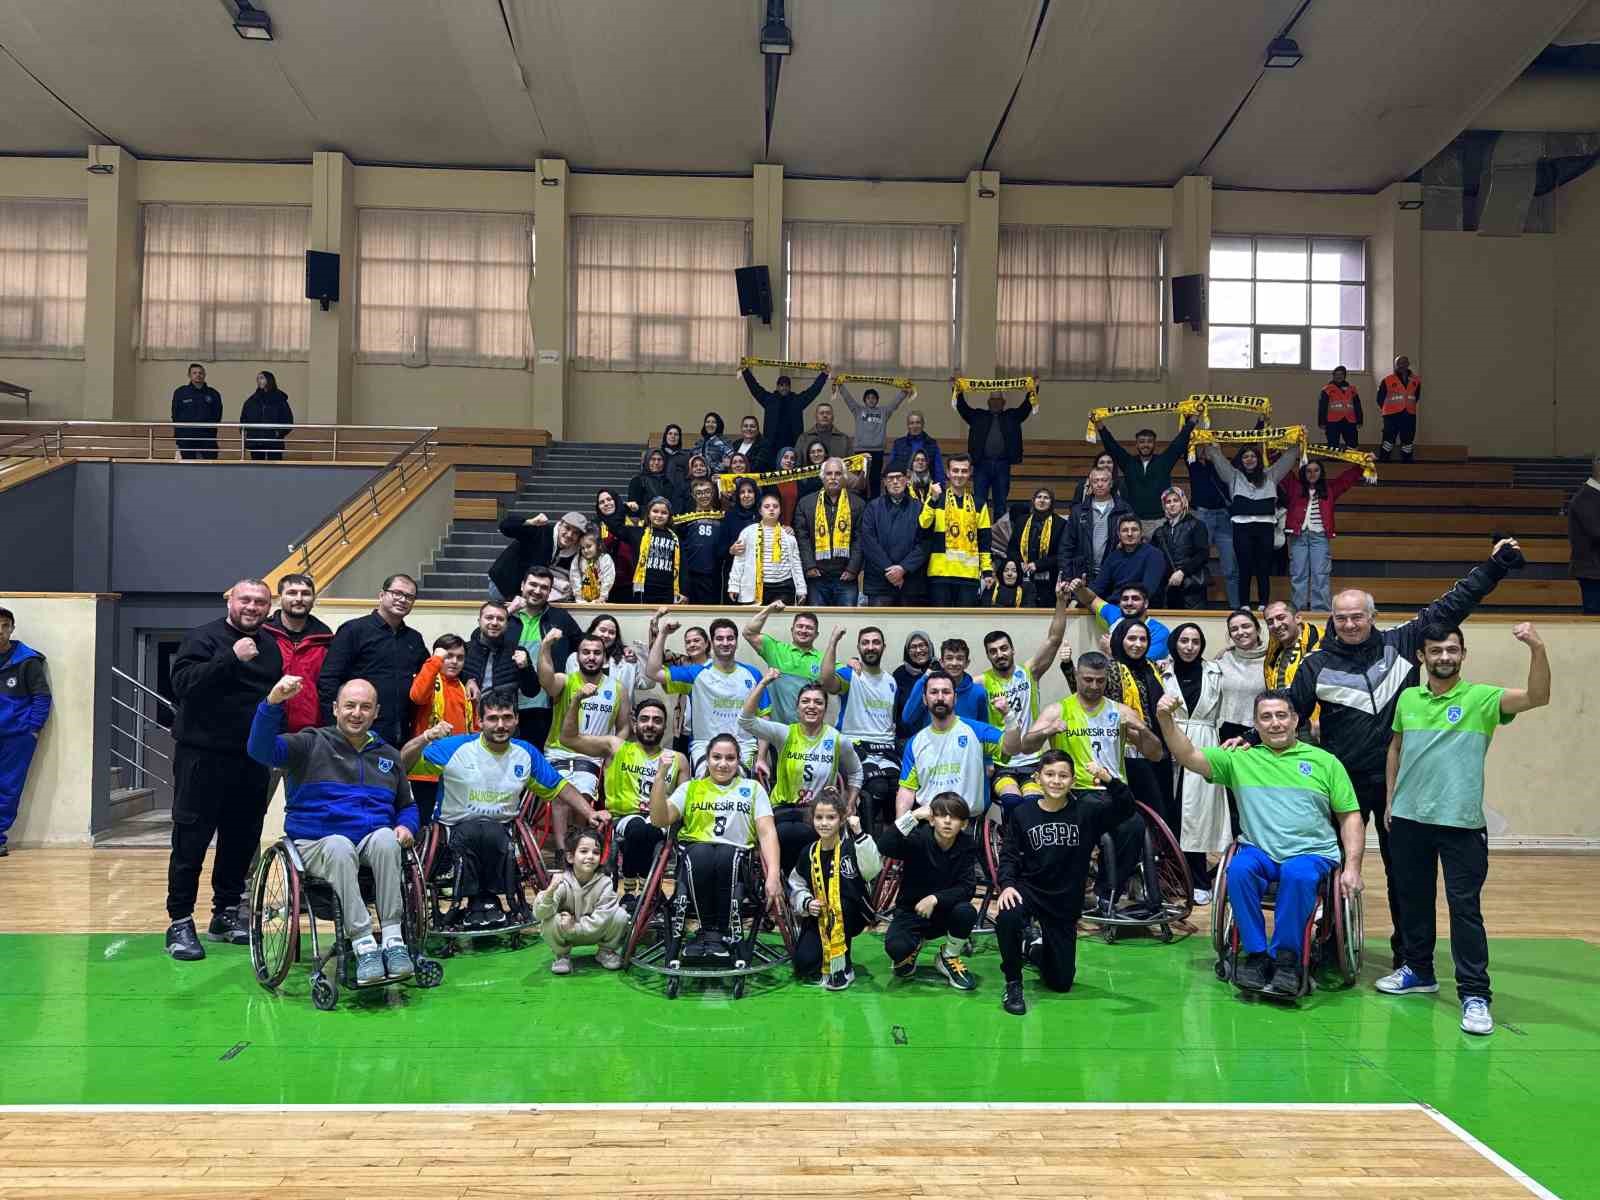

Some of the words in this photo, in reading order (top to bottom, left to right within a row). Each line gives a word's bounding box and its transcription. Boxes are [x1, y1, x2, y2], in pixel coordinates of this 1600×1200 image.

[698, 524, 712, 536] 85
[1091, 741, 1101, 758] 7
[803, 764, 814, 781] 5
[713, 815, 727, 836] 8
[1027, 823, 1080, 851] USPA
